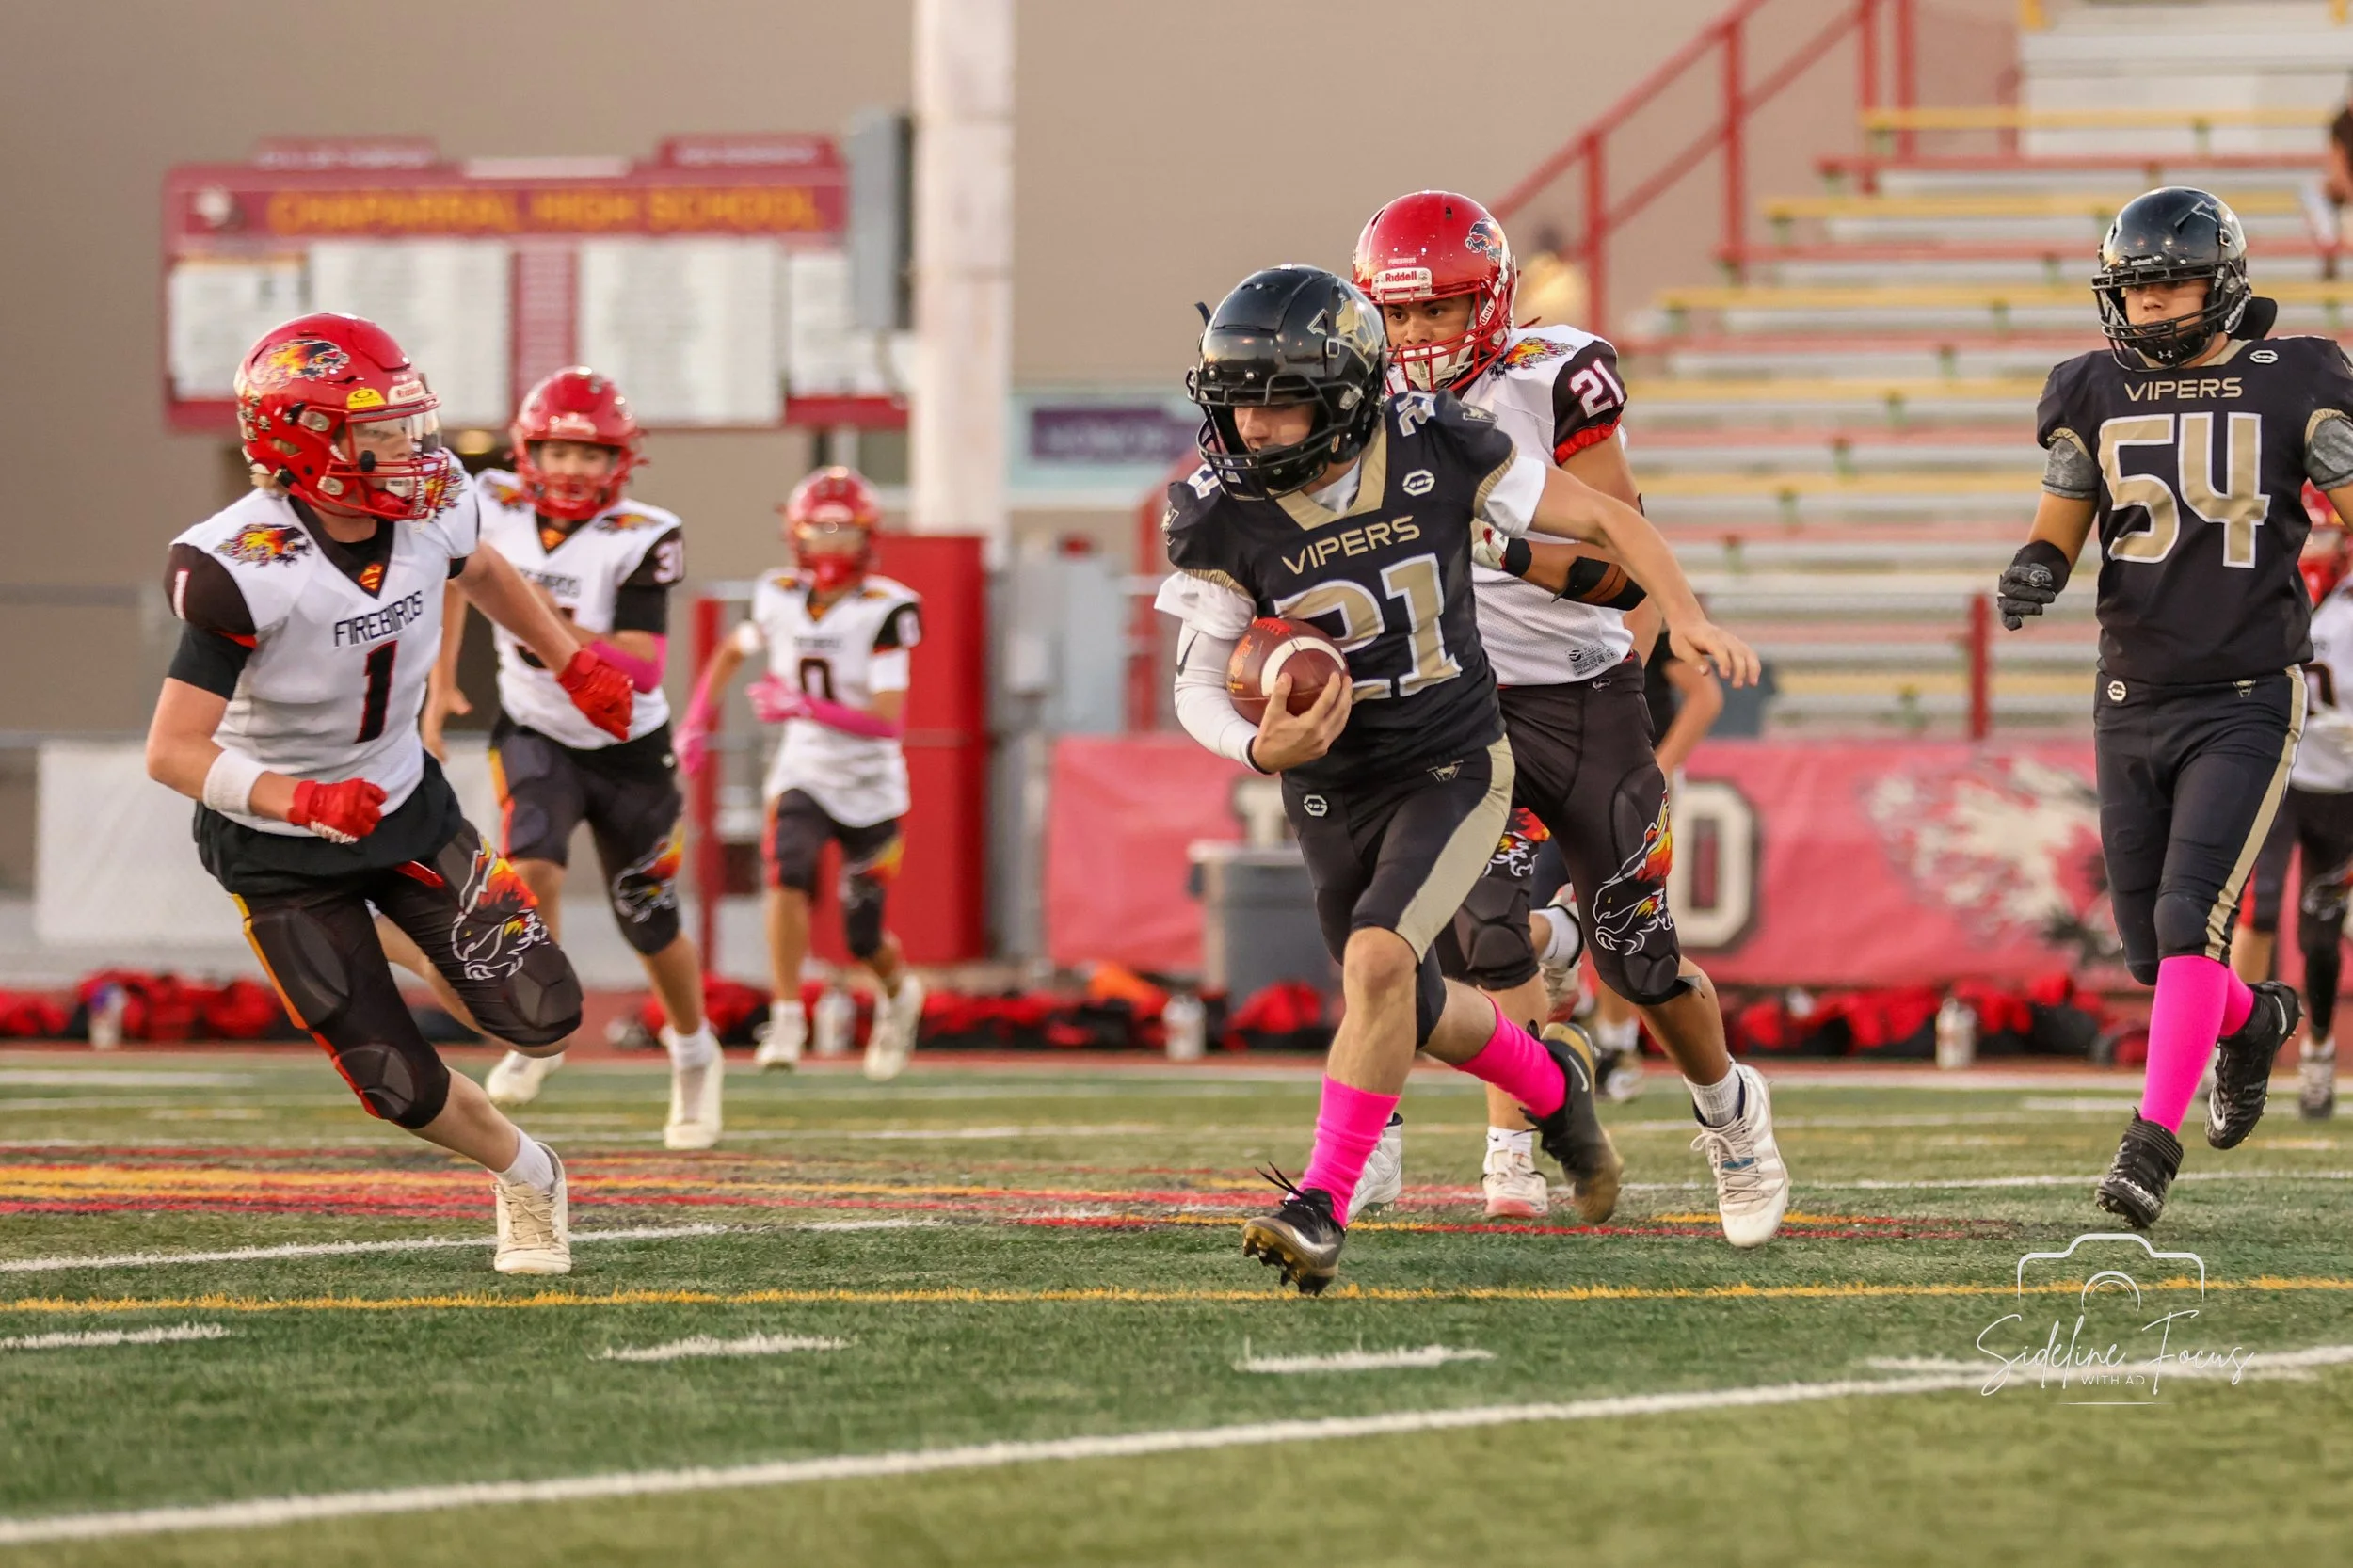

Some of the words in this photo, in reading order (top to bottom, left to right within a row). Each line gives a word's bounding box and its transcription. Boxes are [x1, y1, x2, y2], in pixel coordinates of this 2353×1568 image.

[529, 190, 639, 230] HIGH
[649, 186, 824, 232] SCHOOL
[1385, 270, 1417, 283] Riddell
[1569, 359, 1625, 419] 21
[2123, 377, 2244, 402] VIPERS
[2097, 411, 2271, 568] 54
[1281, 515, 1421, 575] VIPERS
[334, 590, 423, 647] FIREBIRDS
[1273, 552, 1463, 703] 21
[354, 639, 398, 744] 1
